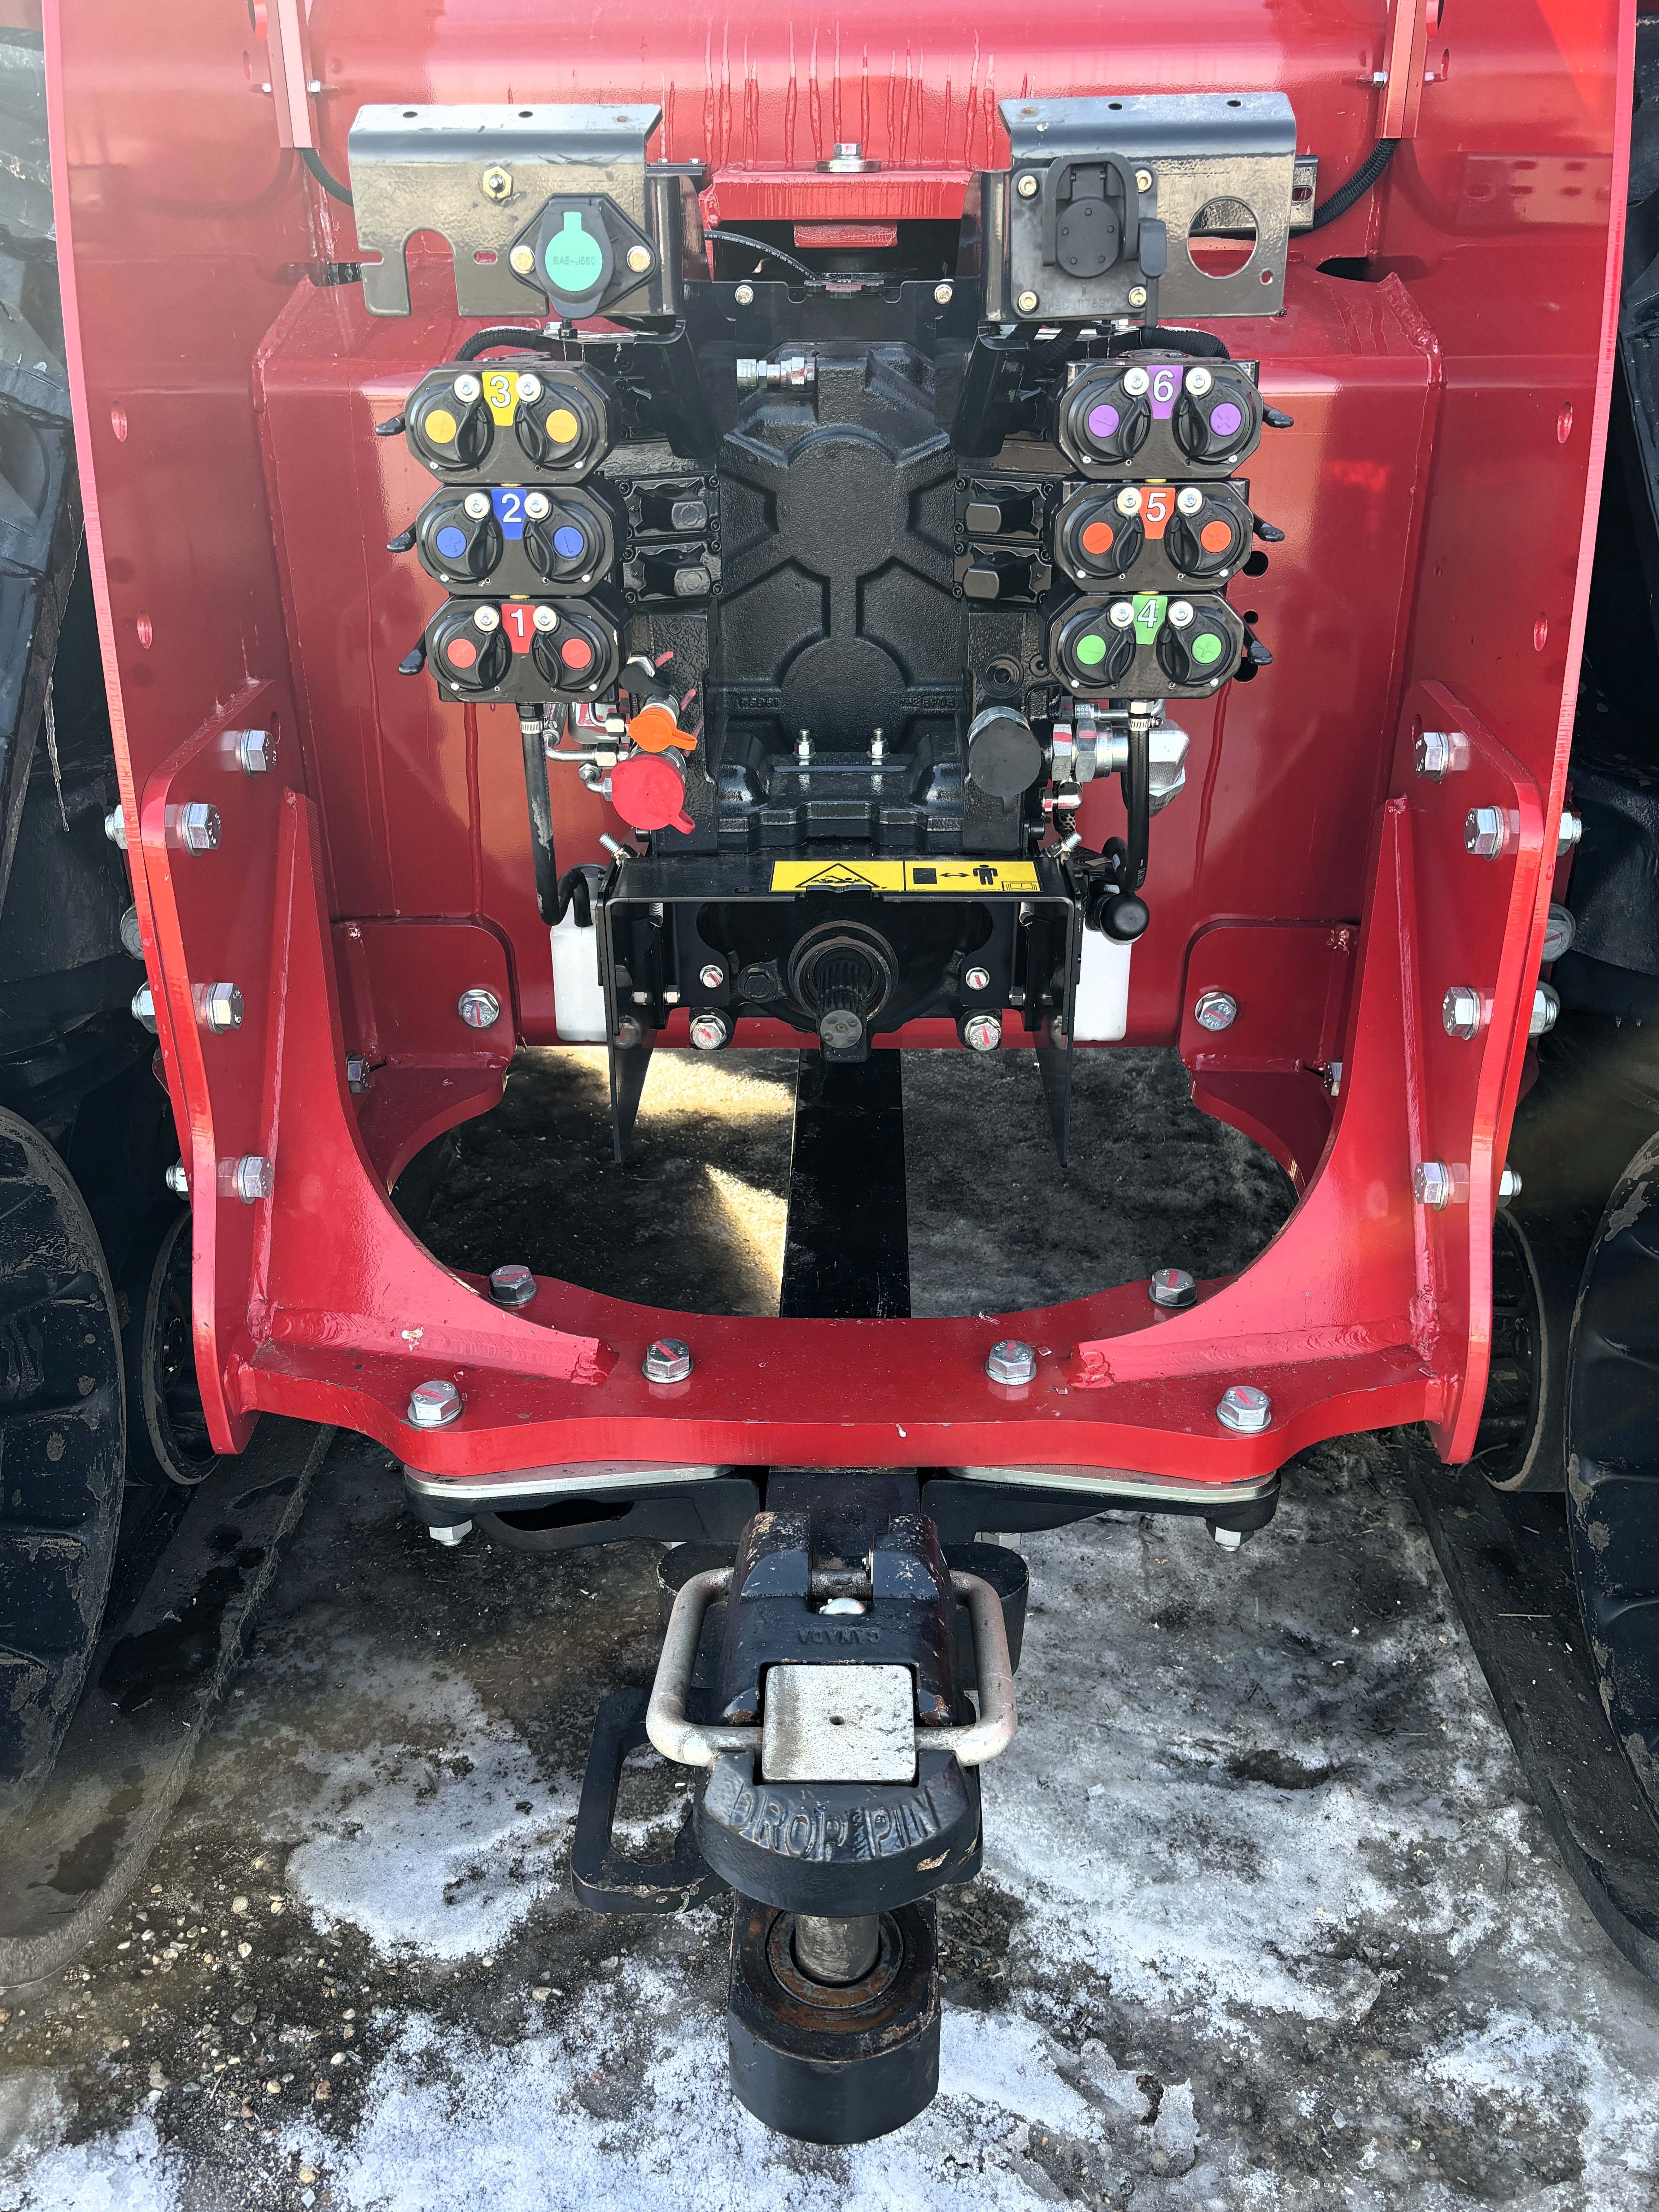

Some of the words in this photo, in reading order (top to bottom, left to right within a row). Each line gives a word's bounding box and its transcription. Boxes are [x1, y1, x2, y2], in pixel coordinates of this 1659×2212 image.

[490, 375, 512, 408] 3
[1153, 369, 1174, 402] 6
[501, 493, 522, 523] 2
[1145, 491, 1167, 523] 5
[510, 608, 524, 637] 1
[1137, 599, 1158, 629] 4
[798, 1626, 879, 1645] CANADA
[728, 1783, 849, 1862] DROP
[864, 1784, 941, 1857] PIN
